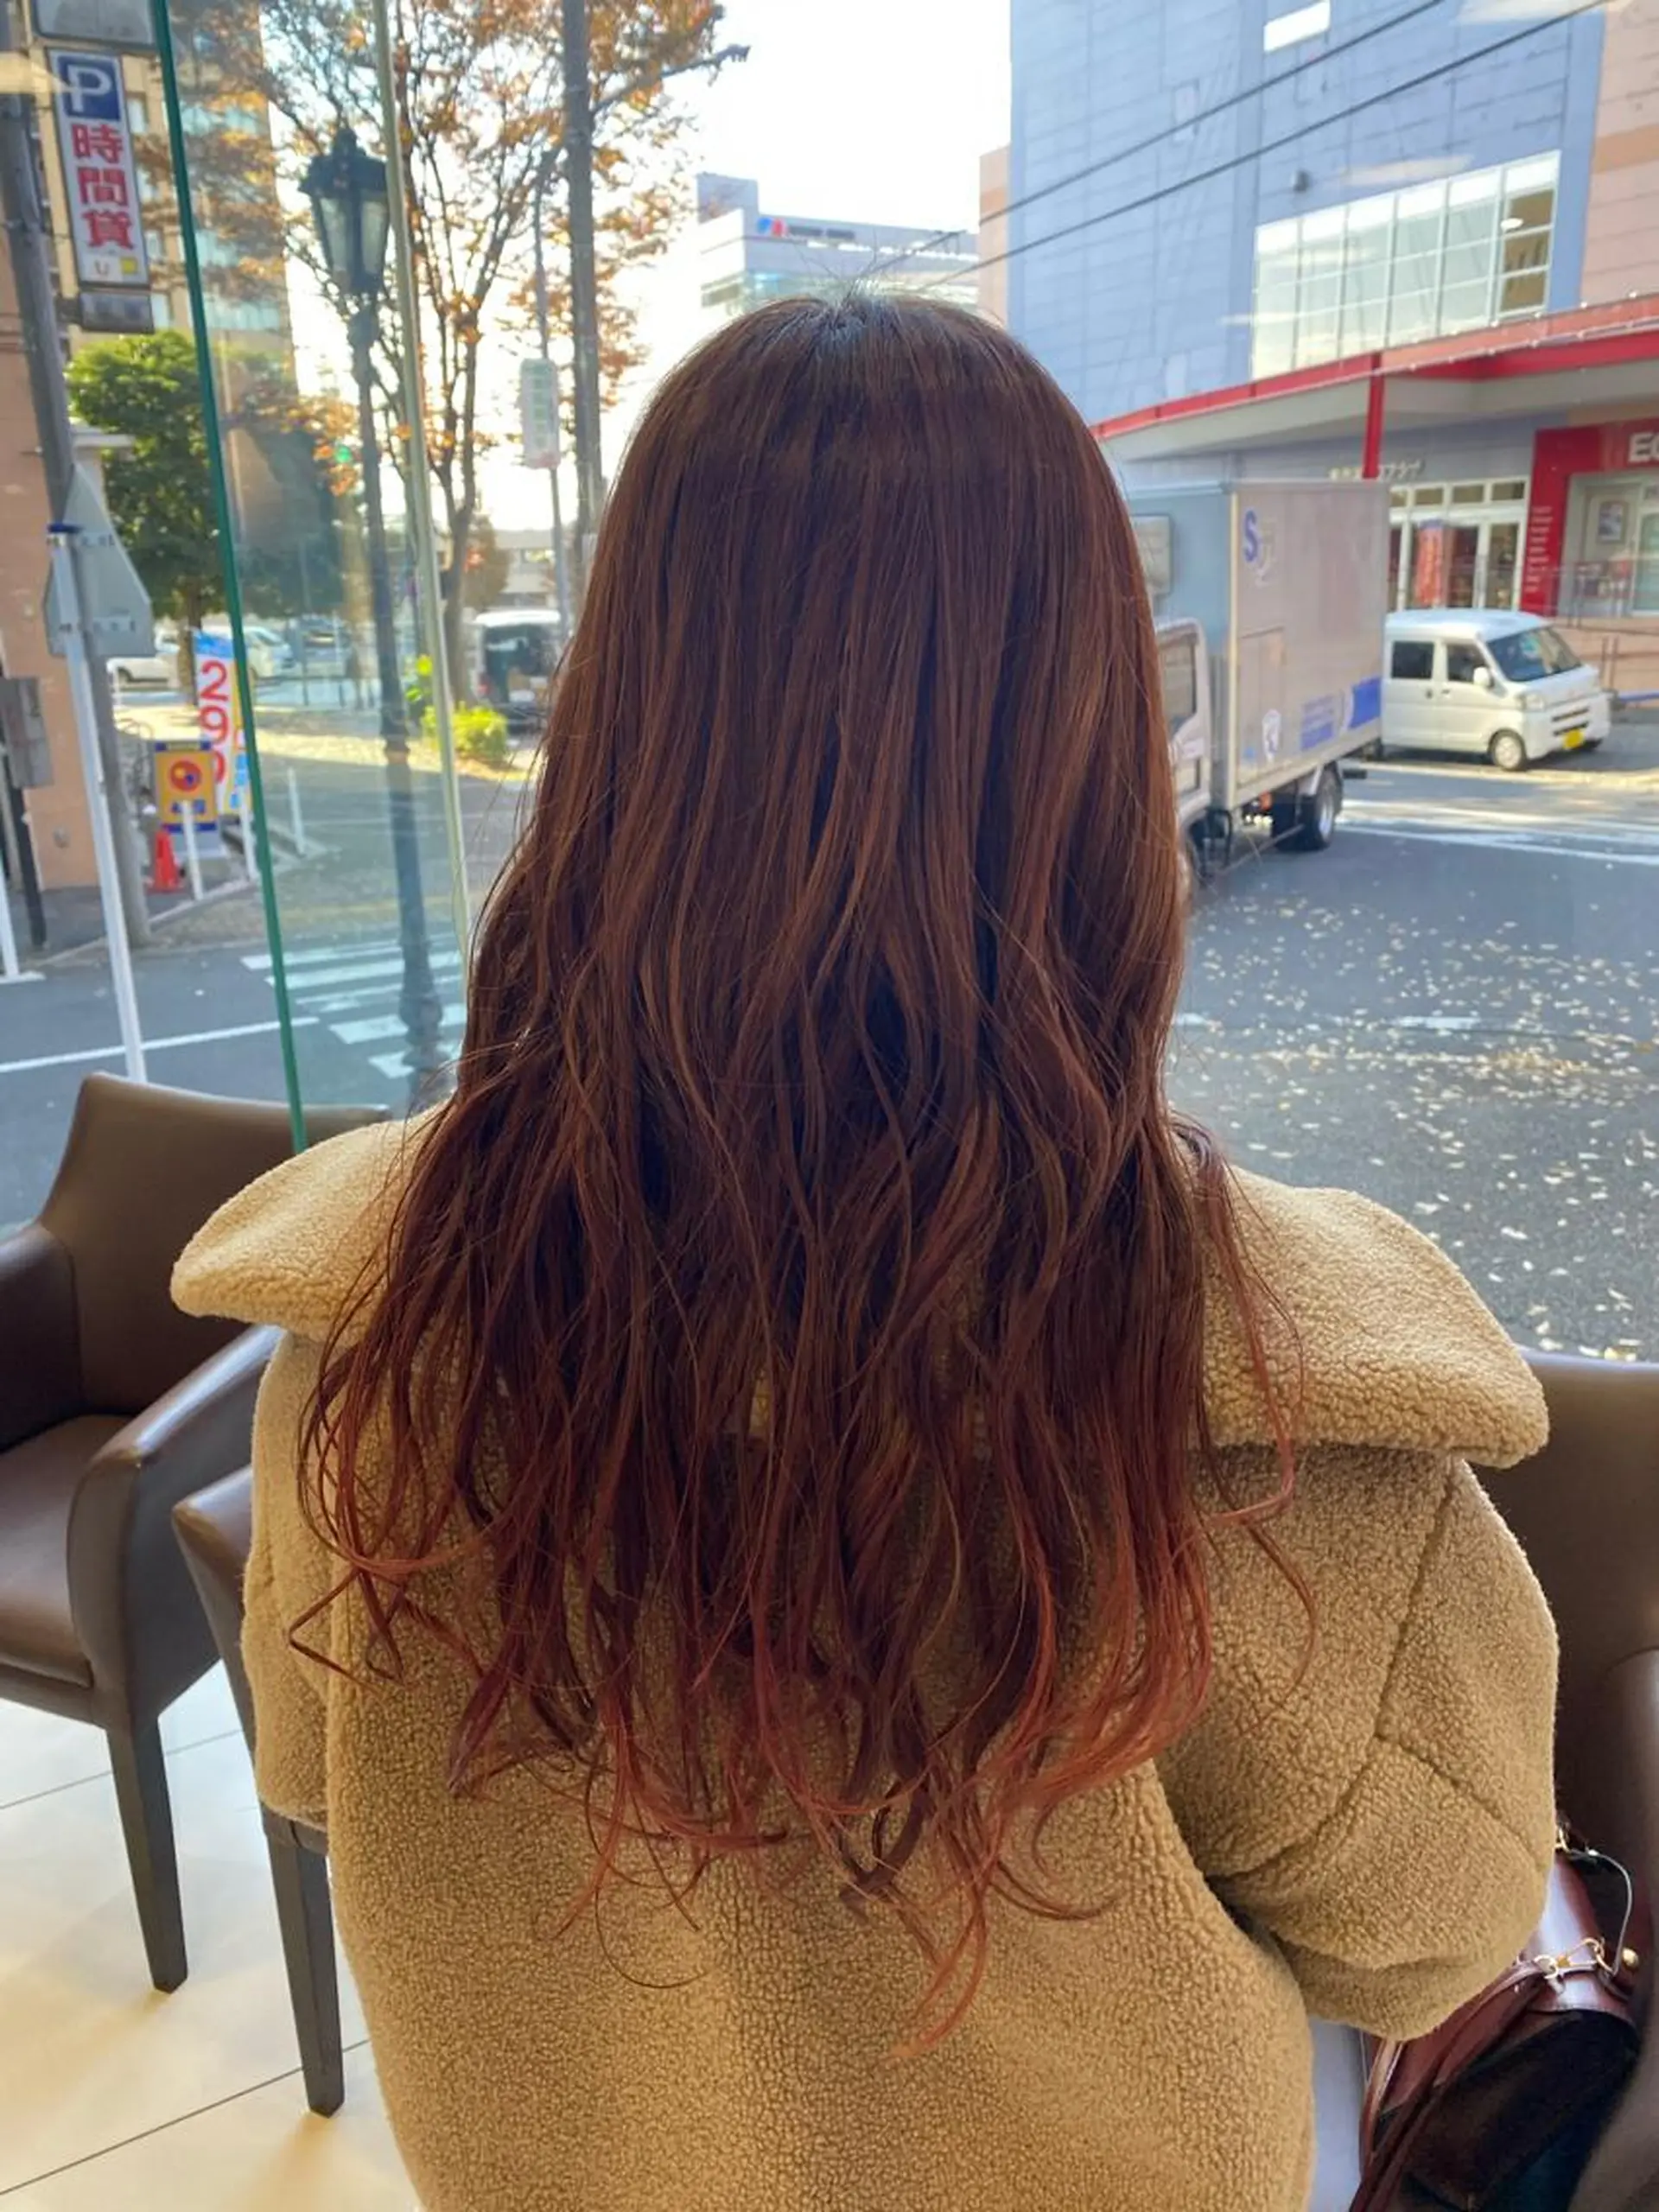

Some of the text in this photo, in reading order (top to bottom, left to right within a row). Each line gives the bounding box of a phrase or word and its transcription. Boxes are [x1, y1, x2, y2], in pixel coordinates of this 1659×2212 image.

[67, 65, 111, 112] P
[72, 124, 134, 249] 時間貸
[1628, 432, 1659, 463] E
